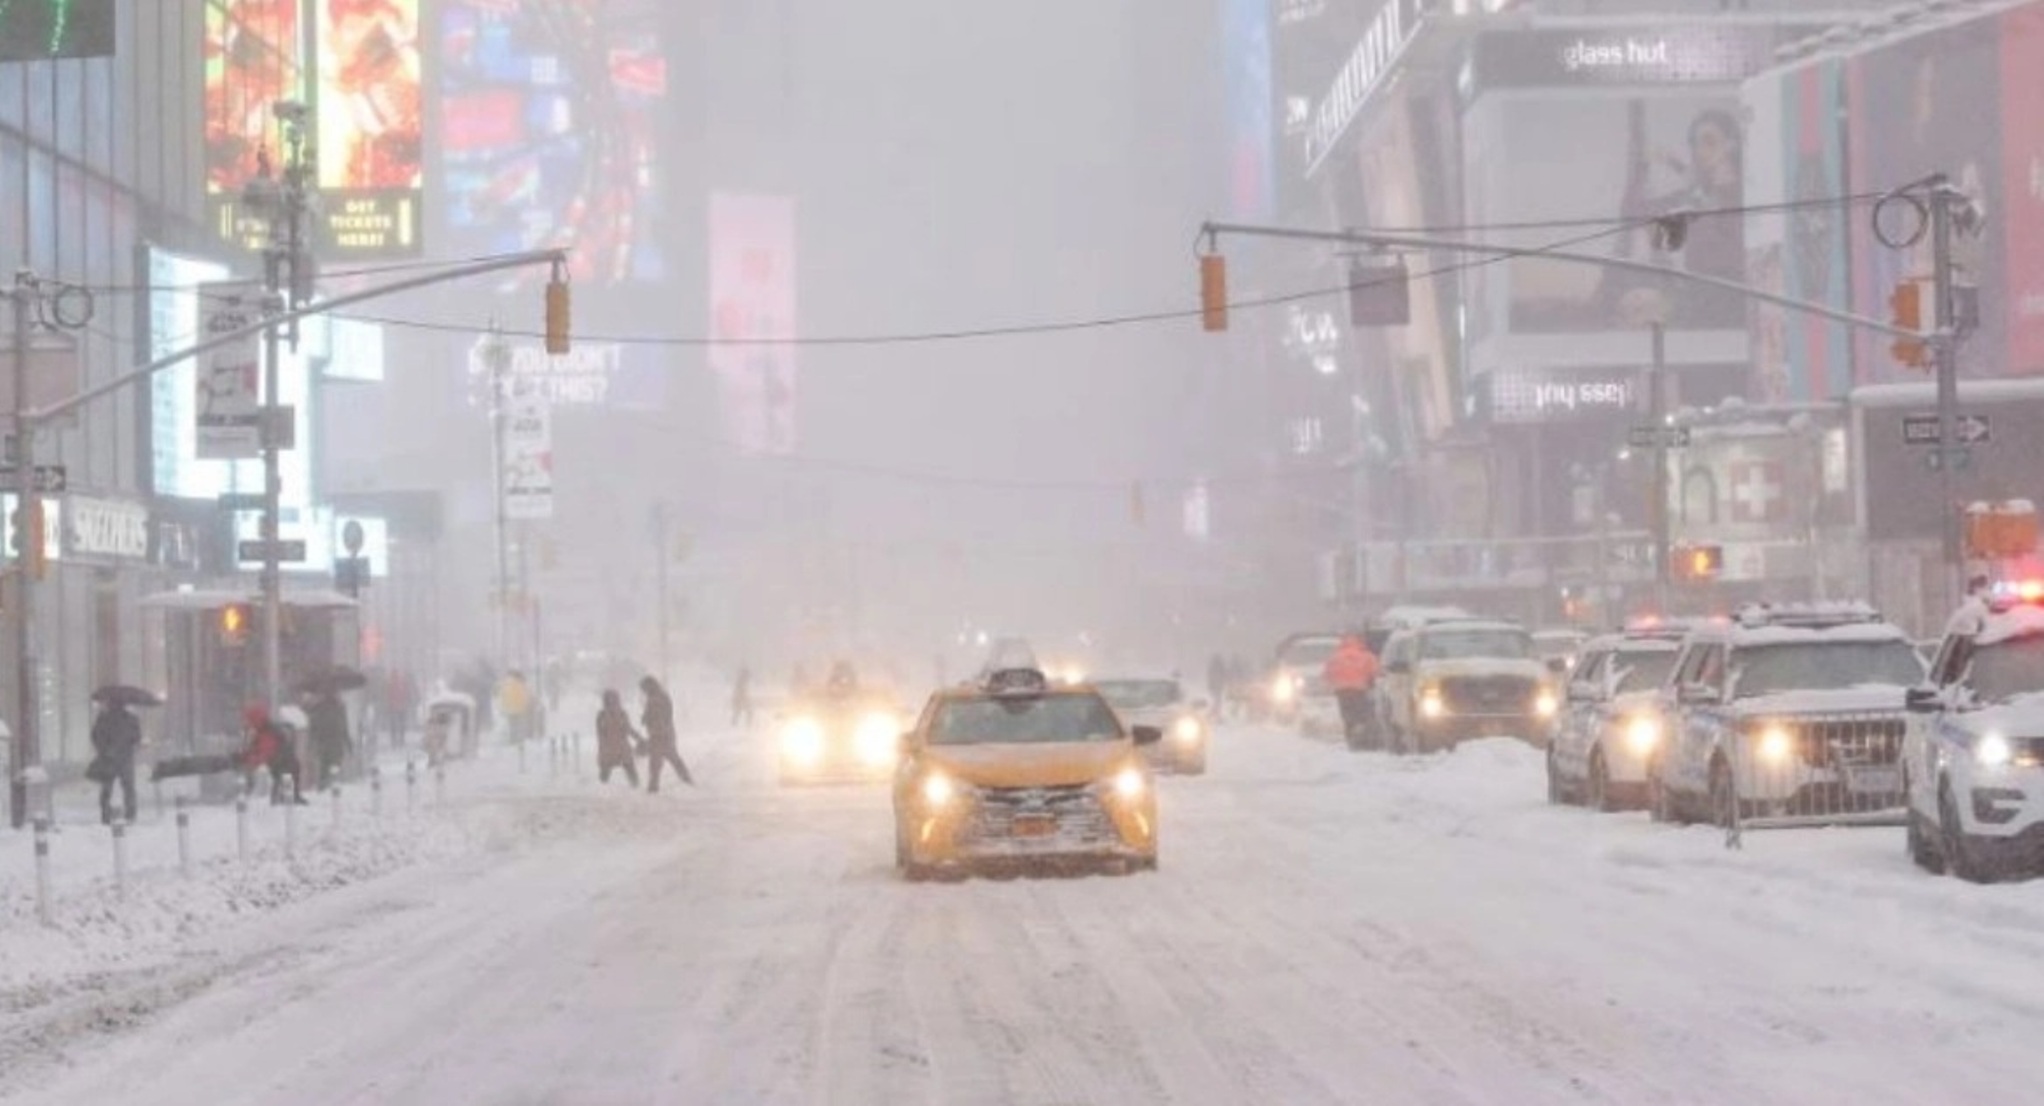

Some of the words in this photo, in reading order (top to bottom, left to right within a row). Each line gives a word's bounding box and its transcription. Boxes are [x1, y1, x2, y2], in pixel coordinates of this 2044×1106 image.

[1564, 38, 1622, 71] glass
[1627, 36, 1667, 64] hut
[330, 215, 391, 229] TICKETS
